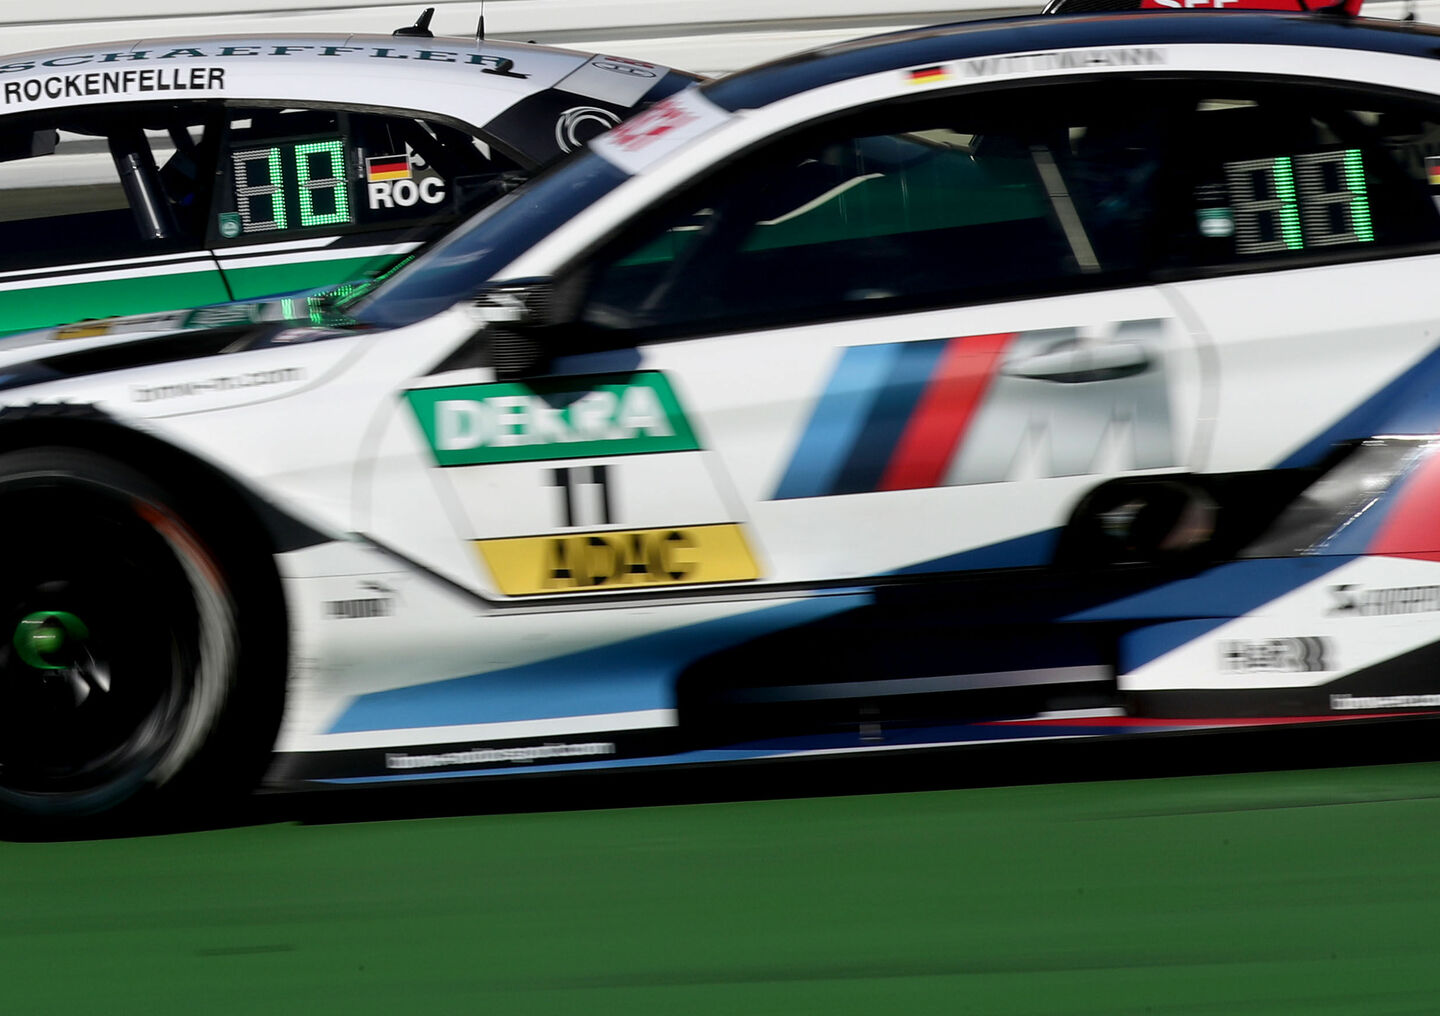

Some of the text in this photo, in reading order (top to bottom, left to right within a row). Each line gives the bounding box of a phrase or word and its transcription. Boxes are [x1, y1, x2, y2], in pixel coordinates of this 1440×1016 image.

[4, 67, 225, 105] ROCKENFELLER
[264, 141, 352, 230] 10
[368, 177, 447, 210] ROC
[432, 386, 677, 452] DEKRA
[544, 465, 616, 528] 11
